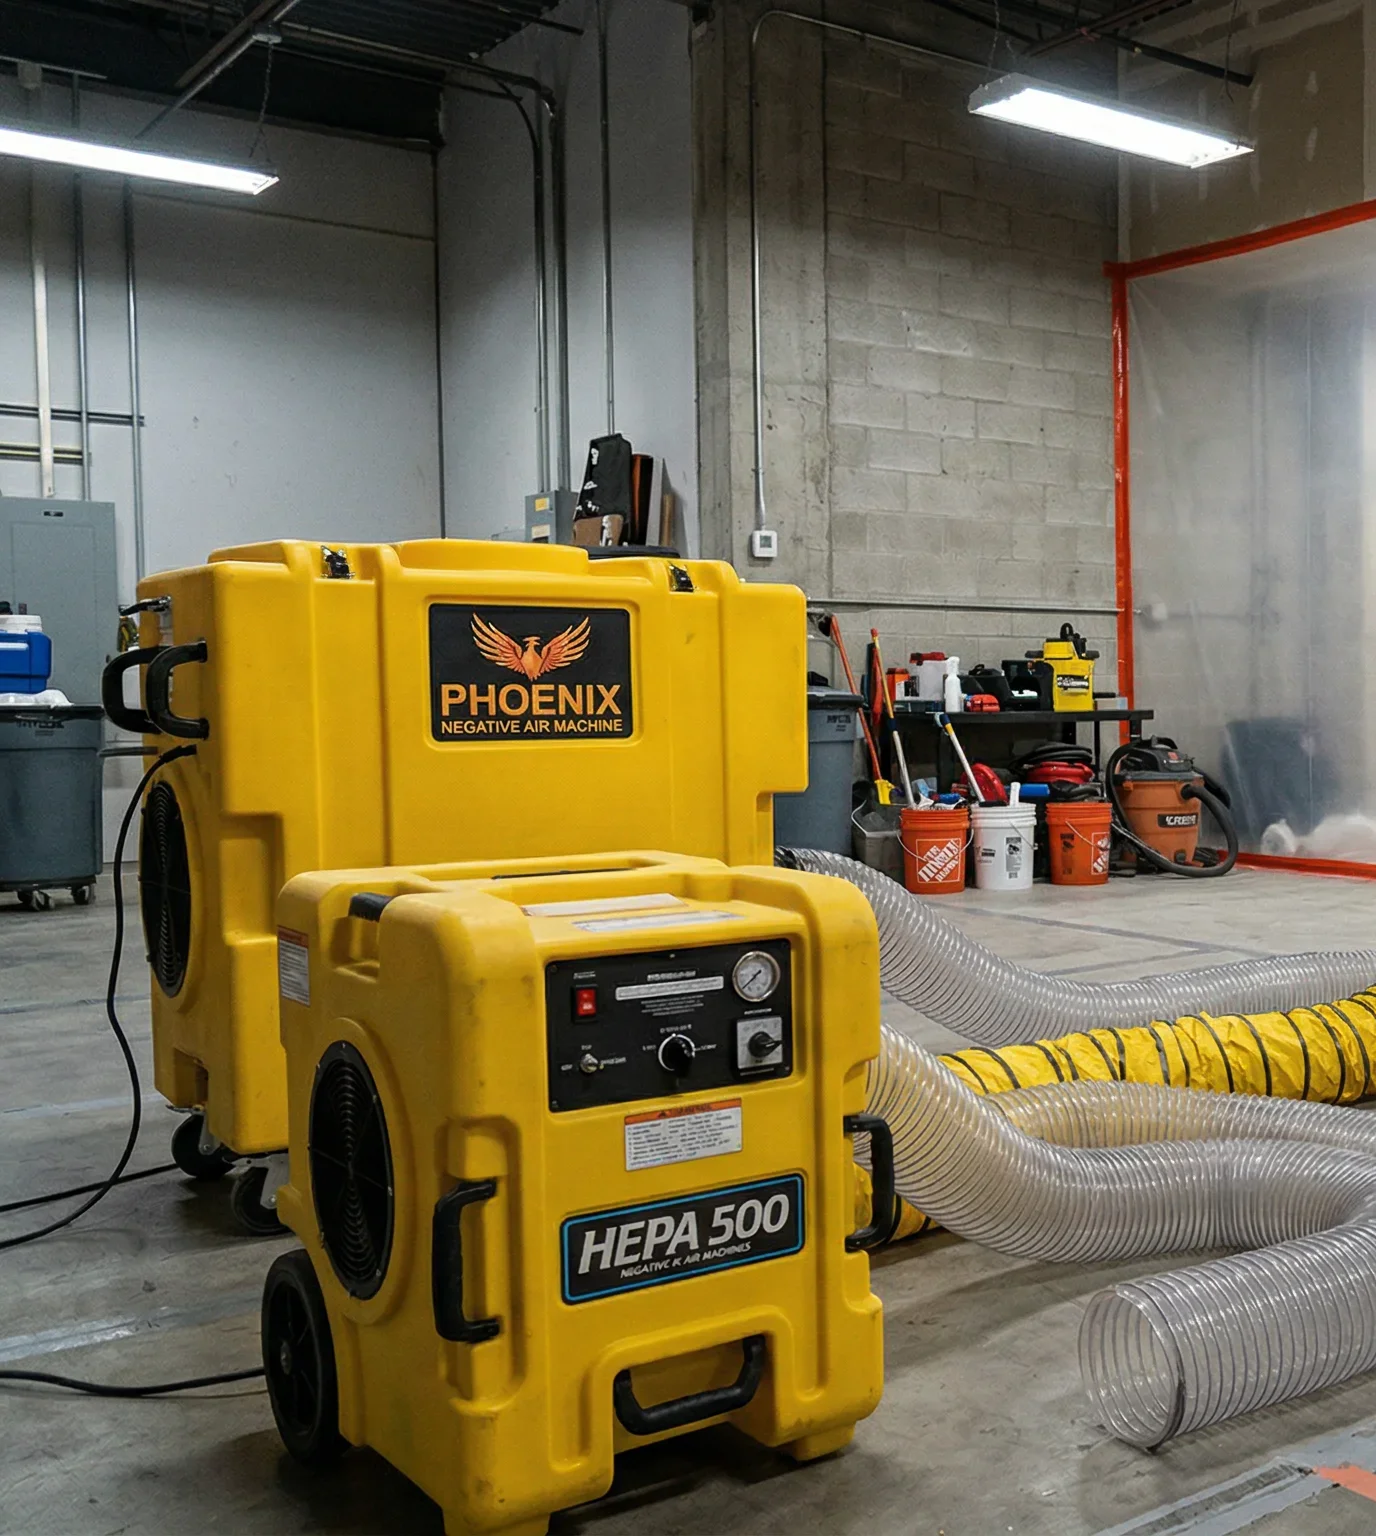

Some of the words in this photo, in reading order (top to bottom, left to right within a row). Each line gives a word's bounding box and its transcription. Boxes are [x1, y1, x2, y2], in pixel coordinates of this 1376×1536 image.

[441, 683, 622, 716] PHOENIX
[441, 720, 520, 734] NEGATIVE
[523, 720, 550, 733] AIR
[554, 719, 622, 733] MACHINE
[578, 1211, 699, 1275] HEPA
[708, 1194, 789, 1247] 500
